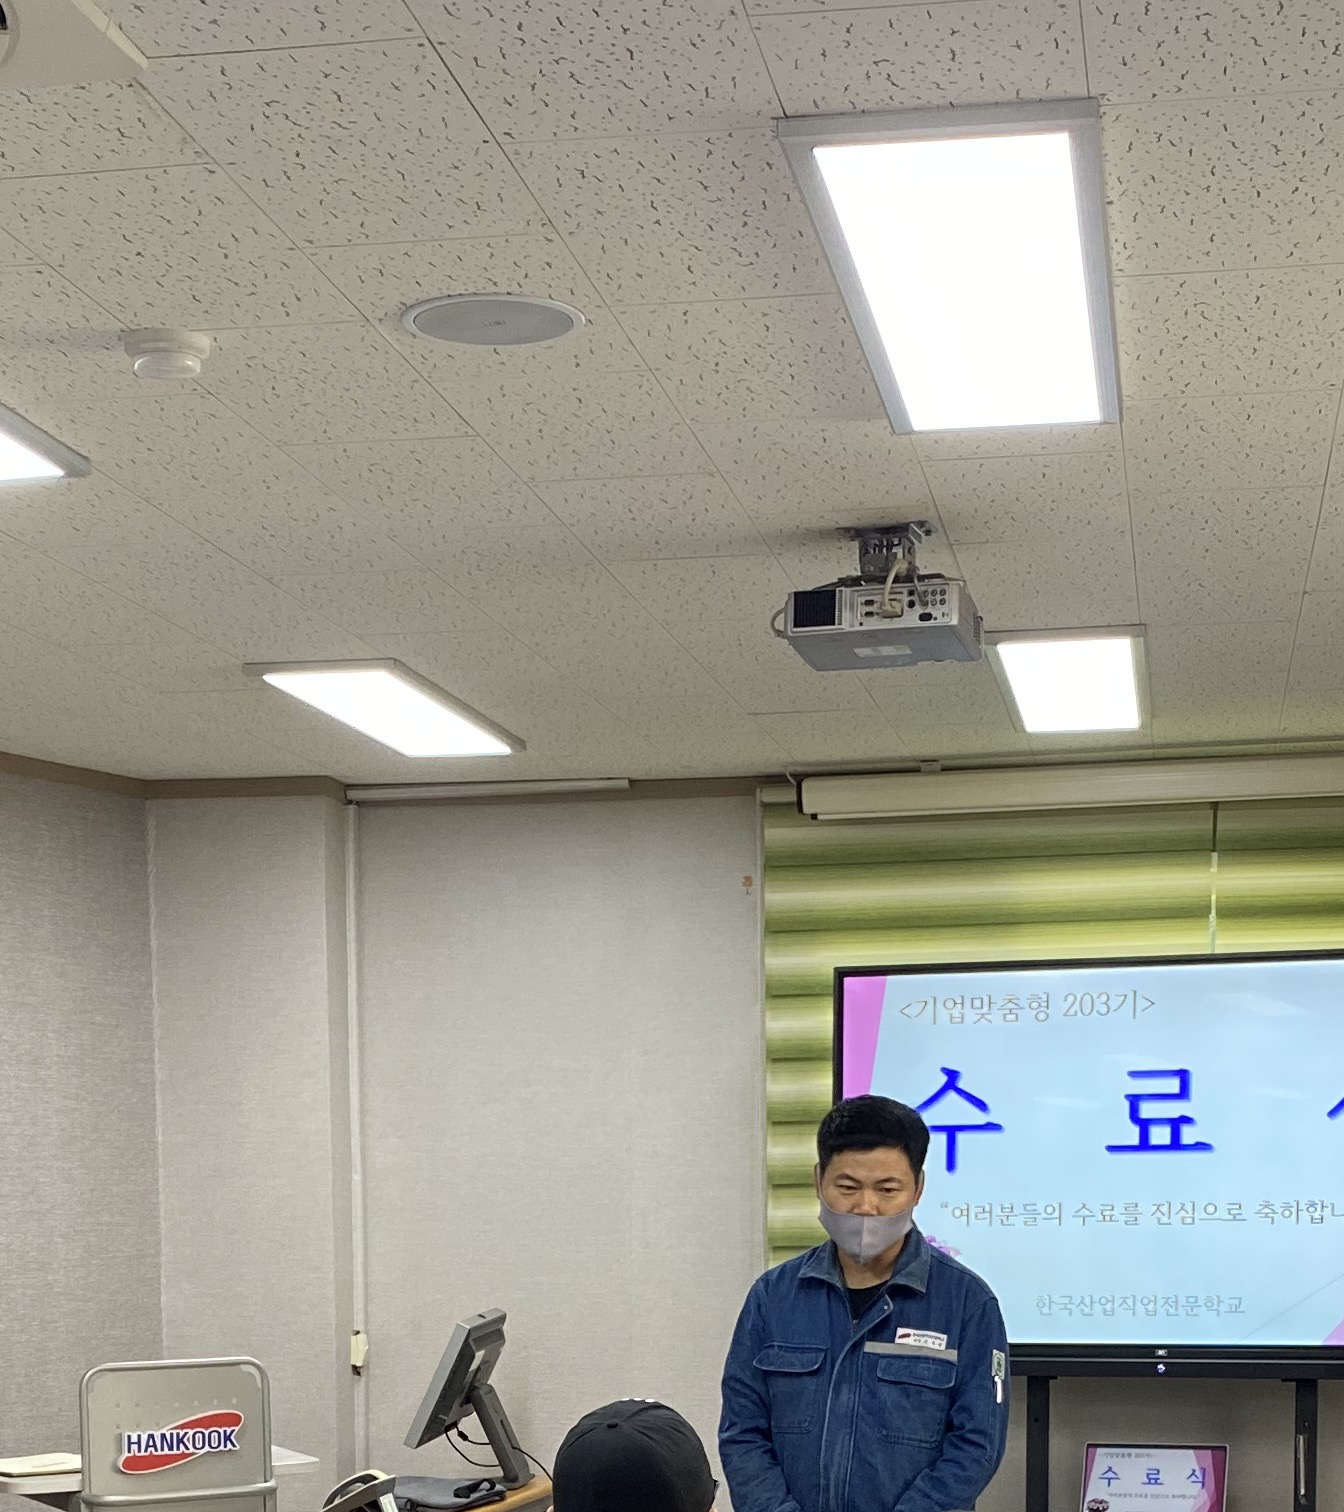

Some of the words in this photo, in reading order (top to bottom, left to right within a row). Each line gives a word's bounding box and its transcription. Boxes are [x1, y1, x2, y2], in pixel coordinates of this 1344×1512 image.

[898, 992, 1051, 1025] <기업맞춤형
[1062, 989, 1157, 1020] 203기>
[913, 1066, 1005, 1175] 수
[1104, 1066, 1214, 1154] 료
[1071, 1200, 1144, 1227] 수료를
[1150, 1200, 1248, 1227] 진심으로
[1034, 1294, 1246, 1318] 한국산업직업전문학교
[126, 1428, 237, 1454] HANKOOK
[1098, 1465, 1121, 1488] 수
[1141, 1467, 1164, 1486] 료
[1186, 1467, 1206, 1490] 식
